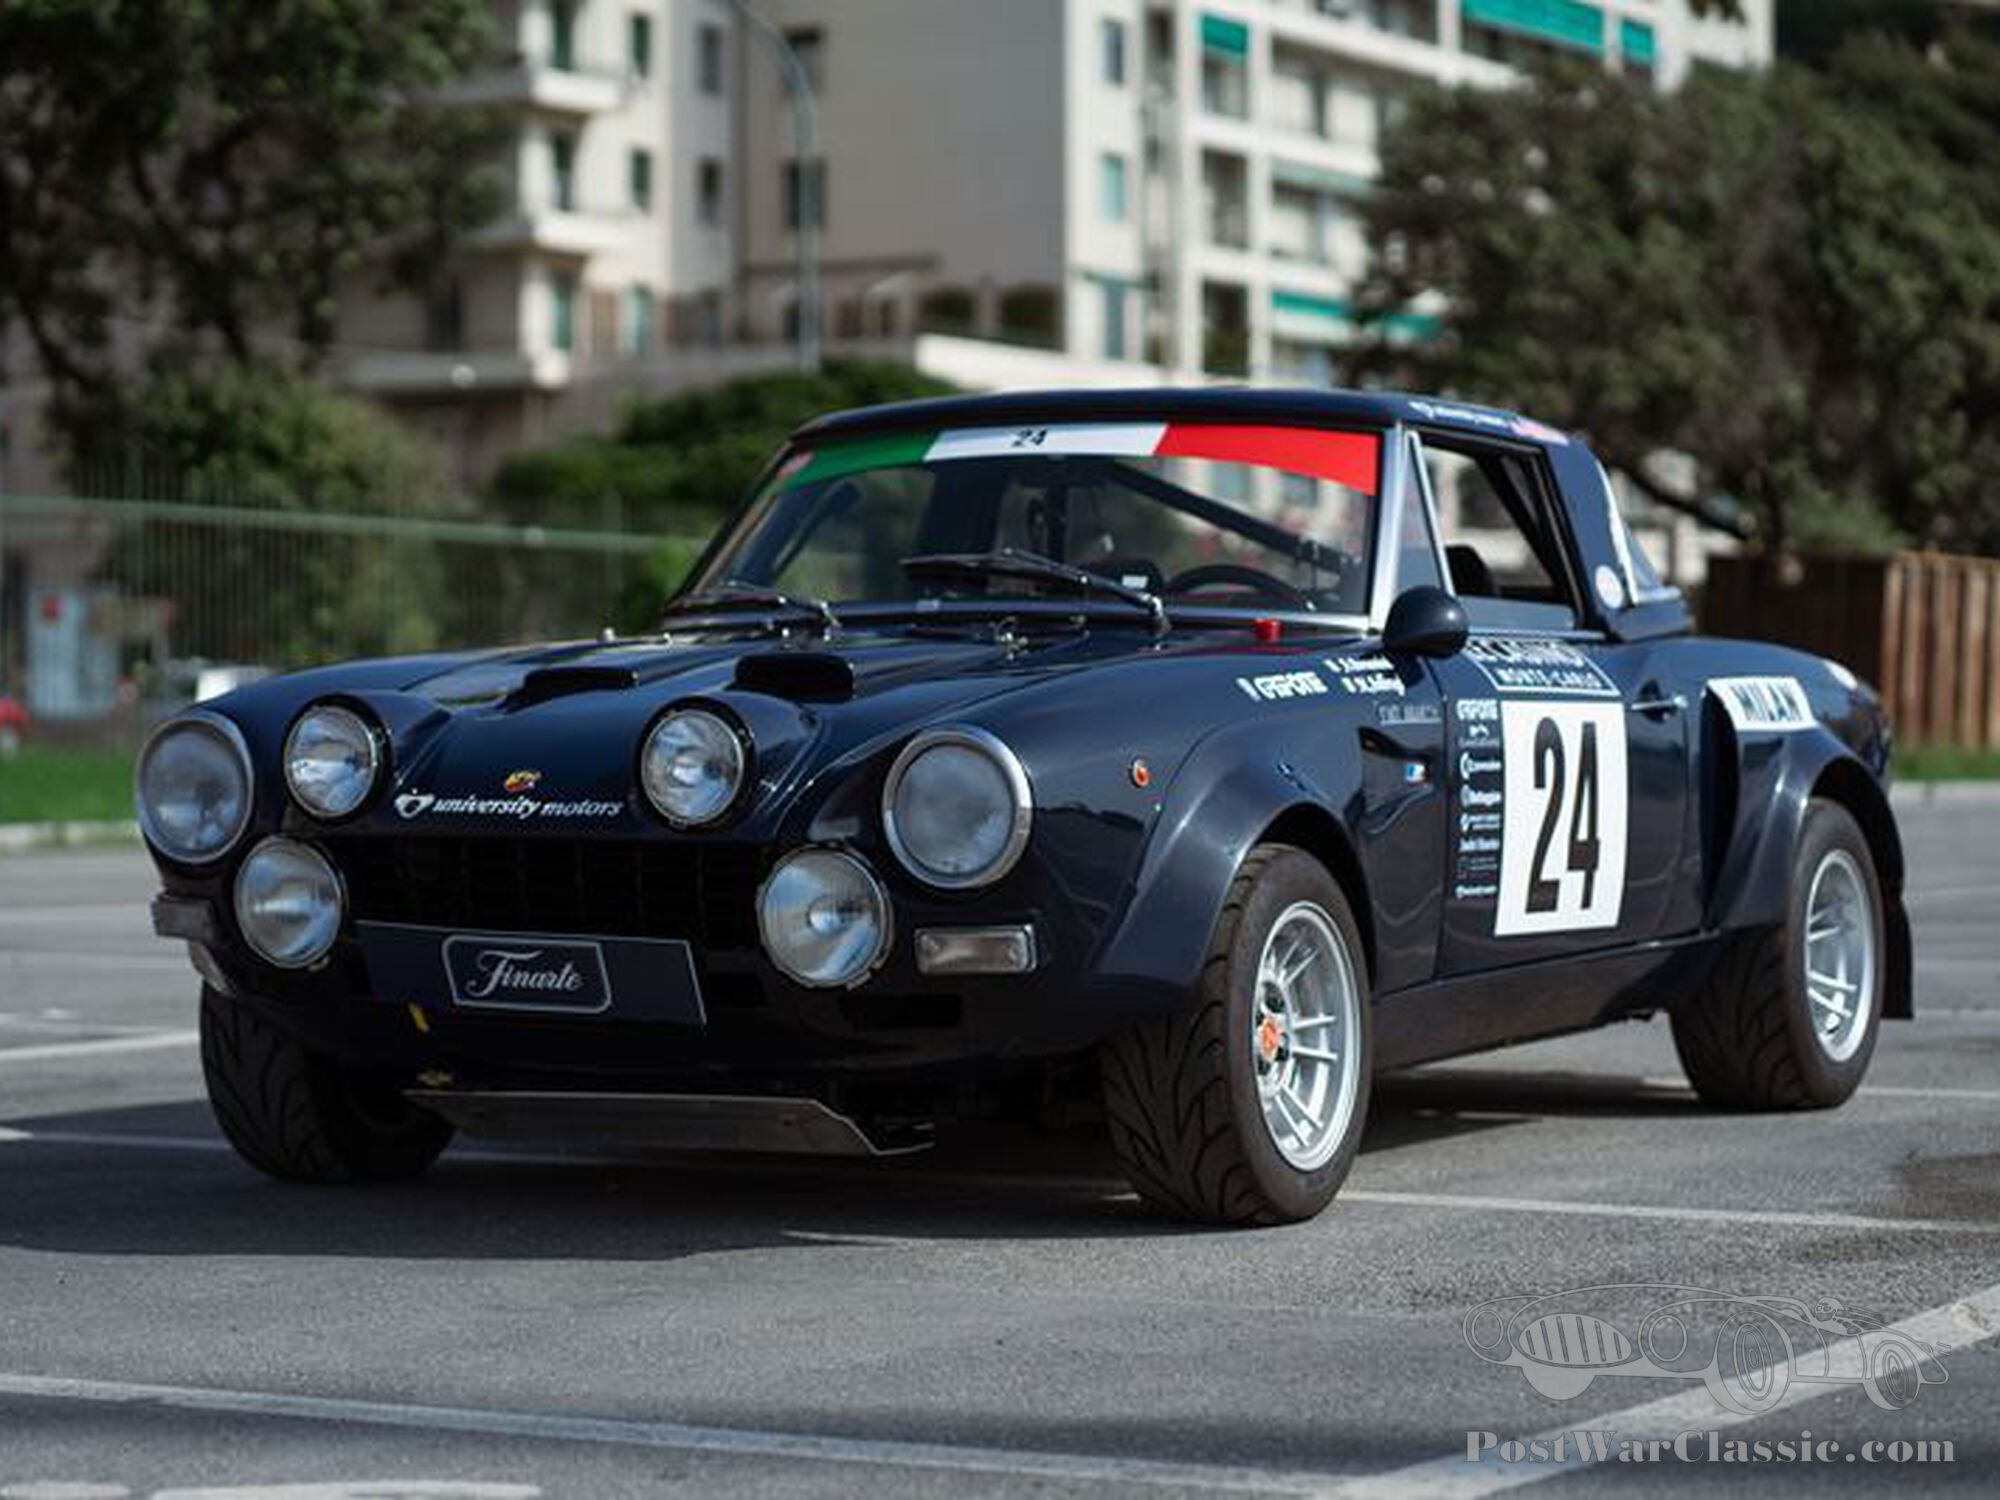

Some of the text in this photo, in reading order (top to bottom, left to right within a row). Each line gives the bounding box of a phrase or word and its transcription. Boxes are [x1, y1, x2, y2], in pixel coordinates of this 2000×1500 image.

[1010, 427, 1047, 448] 24
[1730, 682, 1803, 722] MILAN
[432, 795, 623, 819] university motors
[1525, 716, 1600, 913] 24
[466, 949, 583, 997] Finarte
